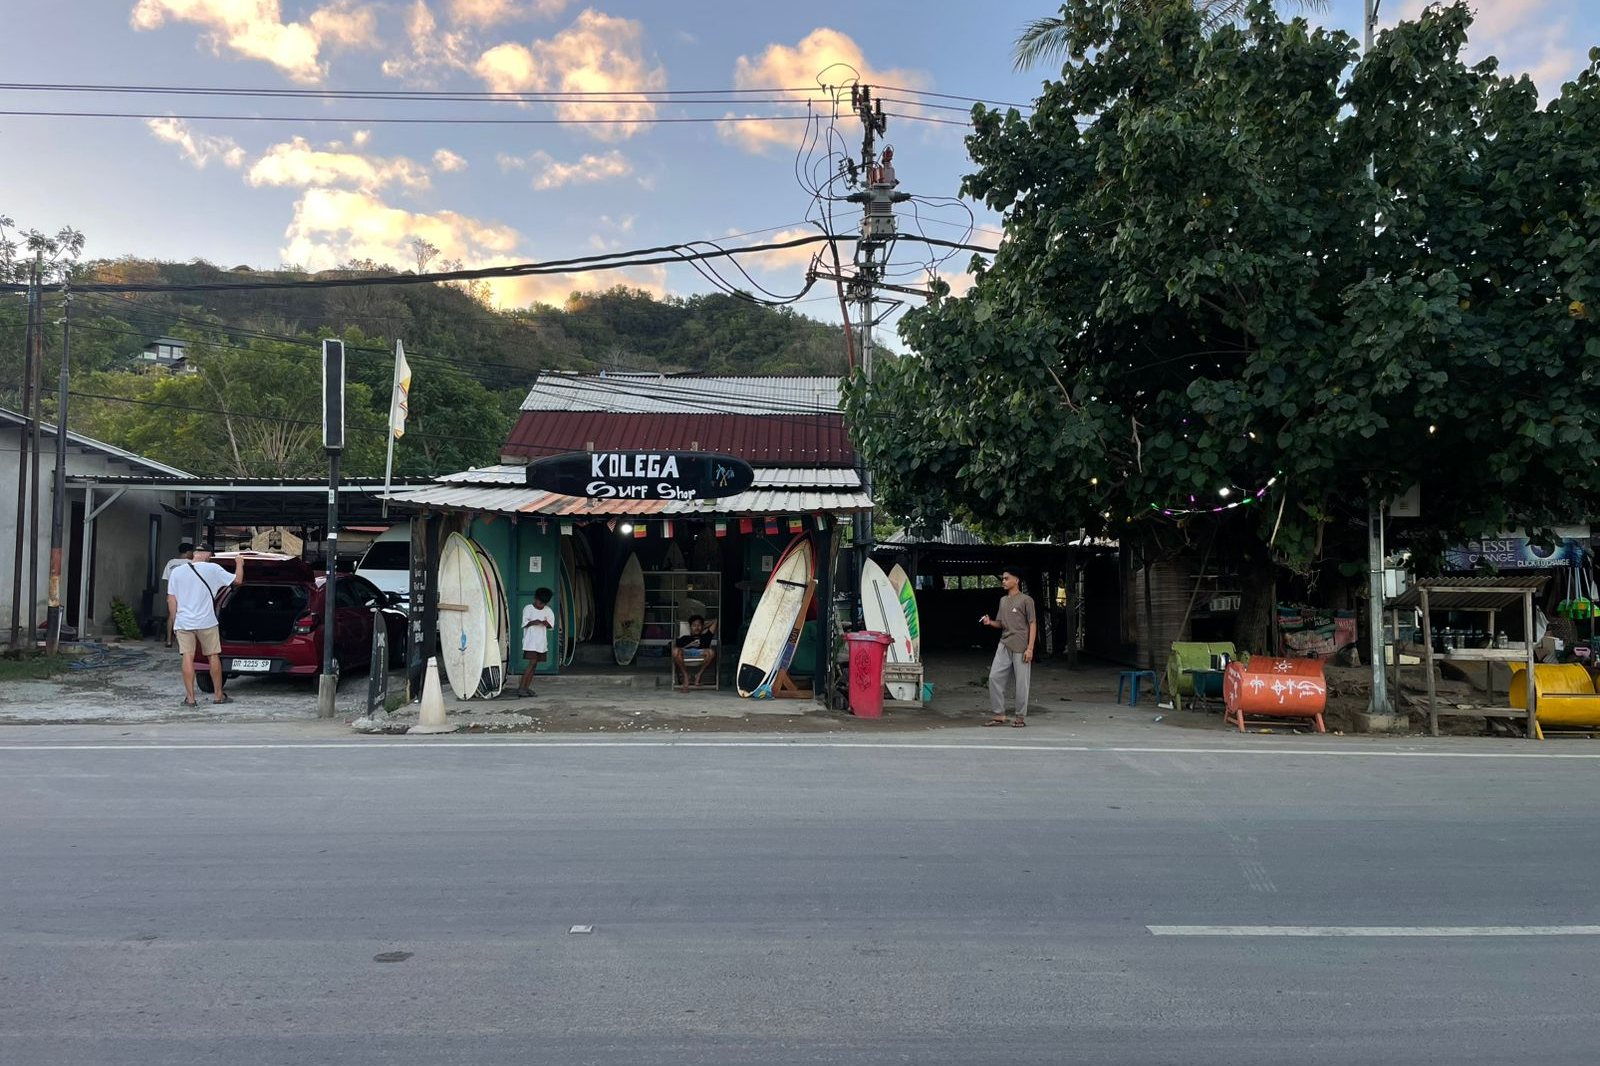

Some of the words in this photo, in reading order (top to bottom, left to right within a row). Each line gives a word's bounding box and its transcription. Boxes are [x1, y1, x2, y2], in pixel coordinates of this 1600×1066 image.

[591, 453, 680, 478] KOLEGA
[585, 481, 649, 499] Surf
[656, 482, 696, 500] Shop
[1482, 540, 1515, 553] ESSE
[1537, 559, 1546, 567] TO
[1546, 559, 1570, 567] CHANGE
